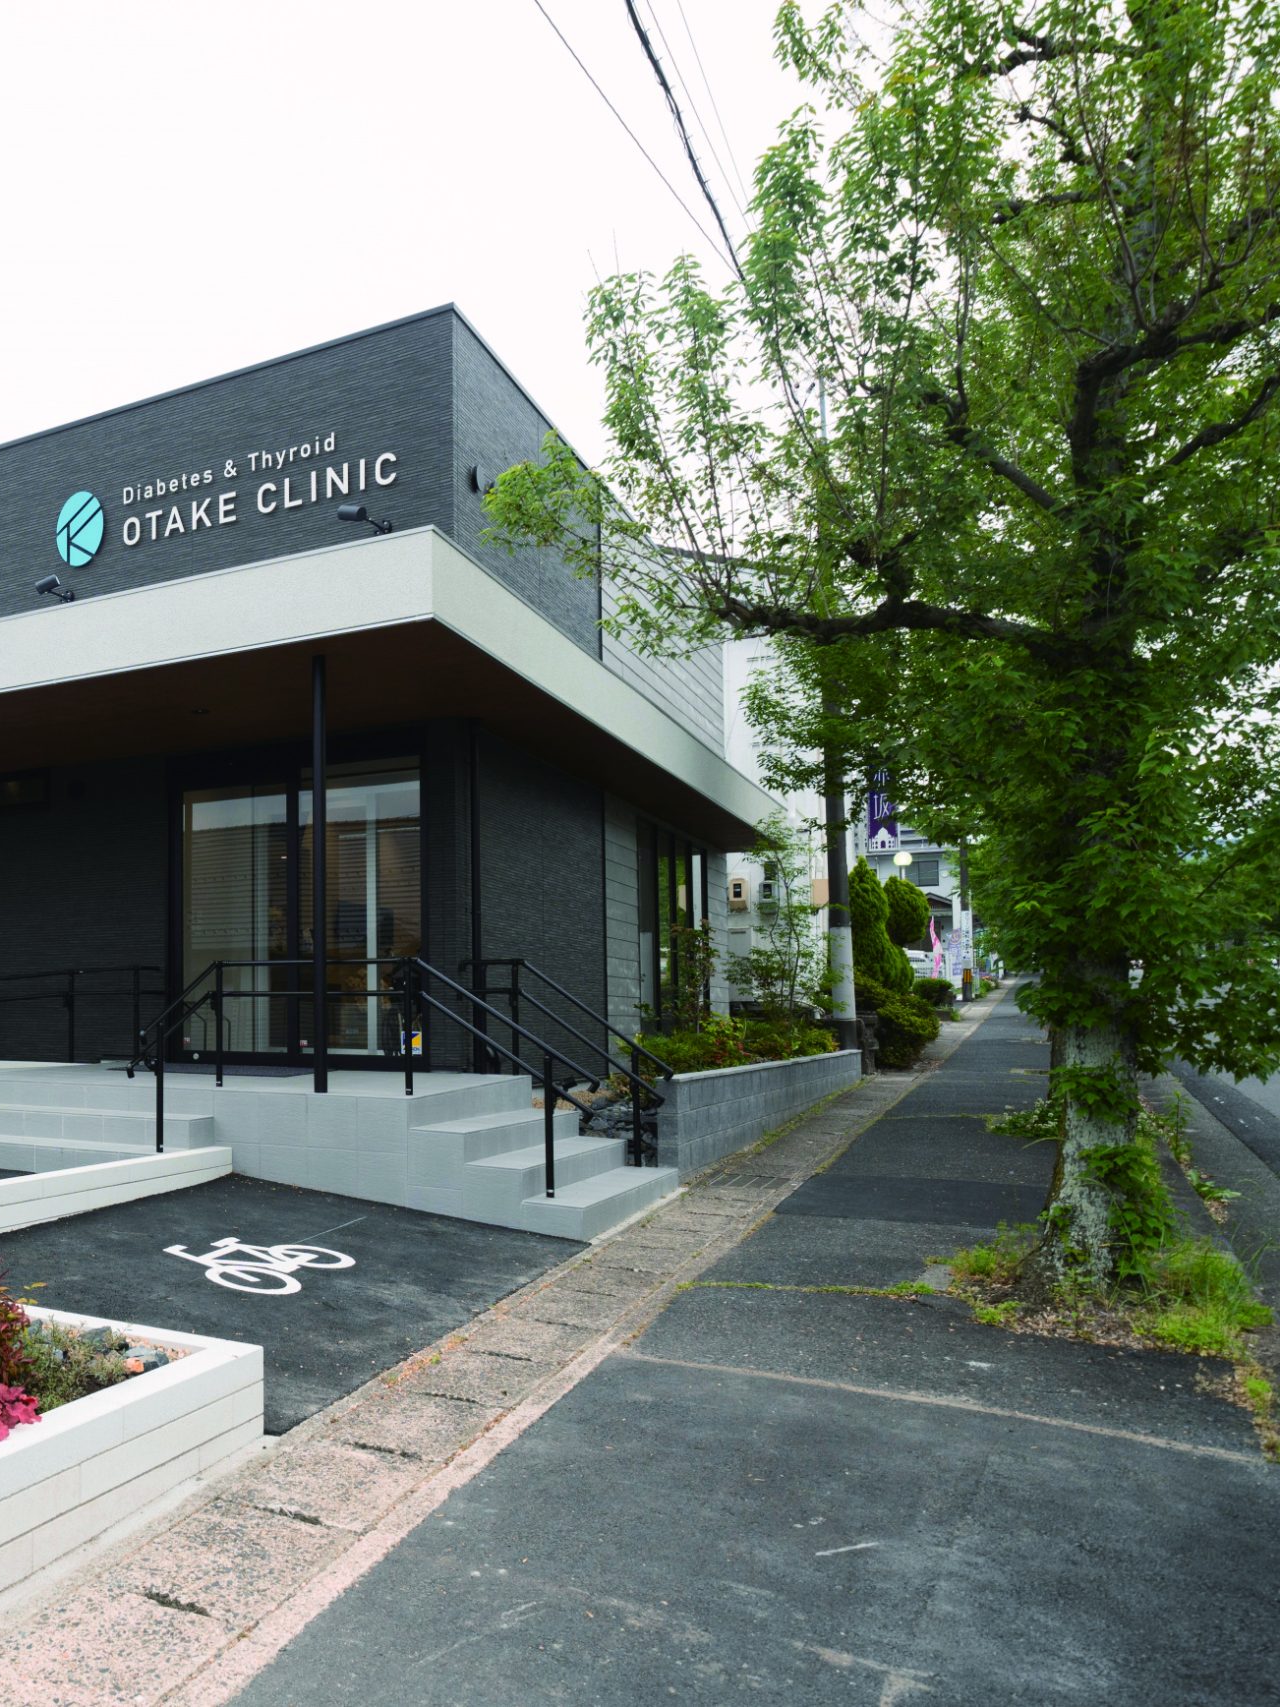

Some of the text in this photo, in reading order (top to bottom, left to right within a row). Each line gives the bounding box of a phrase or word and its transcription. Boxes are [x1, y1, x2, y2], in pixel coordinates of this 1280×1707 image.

[122, 452, 398, 547] OTAKE CLINIC
[123, 432, 336, 505] Diabetes & Thyroid
